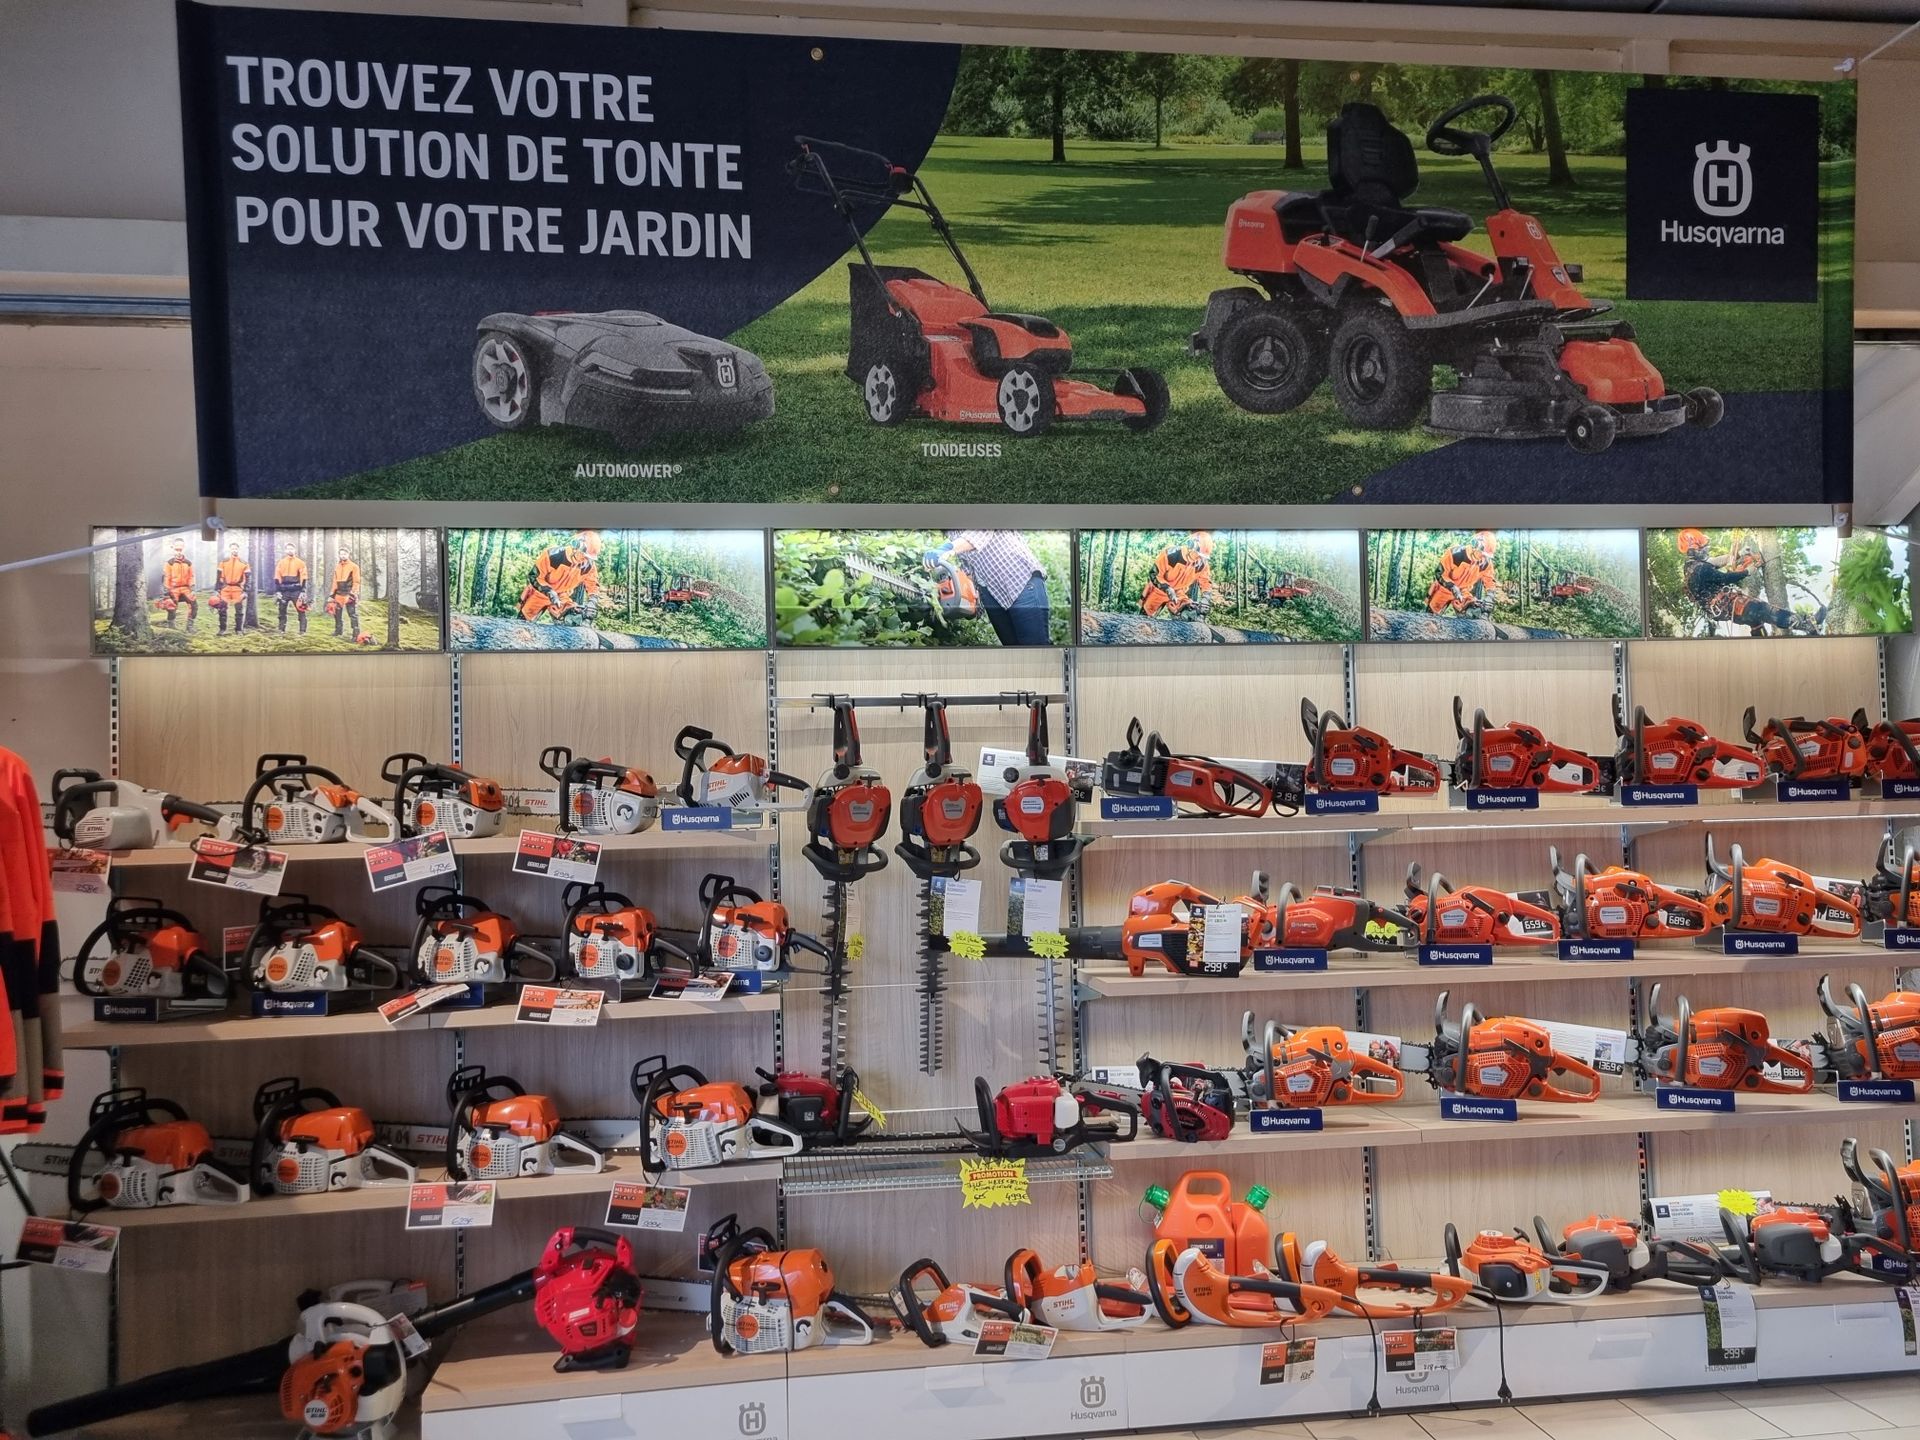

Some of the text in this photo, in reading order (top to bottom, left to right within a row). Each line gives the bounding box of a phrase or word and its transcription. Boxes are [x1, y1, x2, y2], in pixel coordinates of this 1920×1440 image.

[226, 55, 654, 122] TROUVEZ VOTRE
[231, 123, 744, 190] SOLUTION DE TONTE
[235, 195, 752, 260] POUR VOTRE JARDIN
[1660, 219, 1786, 247] Husqvarna
[921, 442, 1002, 457] TONDEUSES
[575, 462, 682, 479] AUTOMOWER®
[707, 780, 727, 791] STIHL
[1642, 792, 1684, 800] Husqvarna
[1797, 787, 1837, 796] Husqvarna
[1325, 799, 1366, 809] Husqvarna
[1486, 795, 1526, 803] Husqvarna
[1120, 804, 1160, 814] Husqvarna
[681, 816, 719, 824] Husqvarna
[1828, 909, 1851, 919] 869€
[1524, 920, 1547, 930] 659€
[1668, 915, 1691, 927] 689€
[1744, 940, 1785, 949] Husqvarna
[1438, 951, 1480, 960] Husqvarna
[1579, 946, 1621, 955] Husqvarna
[1274, 956, 1314, 965] Husqvarna
[273, 1001, 314, 1010] Husqvarna
[1599, 1061, 1622, 1072] 1369€
[1858, 1087, 1901, 1097] Husqvarna
[1678, 1095, 1721, 1106] Husqvarna
[1461, 1104, 1504, 1115] Husqvarna
[1270, 1116, 1310, 1126] Husqvarna
[417, 1135, 448, 1144] STIH
[220, 1147, 247, 1157] STIH
[44, 1155, 70, 1165] STIH
[972, 1170, 1014, 1180] PROMOTION
[1053, 1298, 1075, 1308] STIHL
[1395, 1383, 1440, 1395] Husqvarna
[1070, 1408, 1118, 1420] Husqvarna
